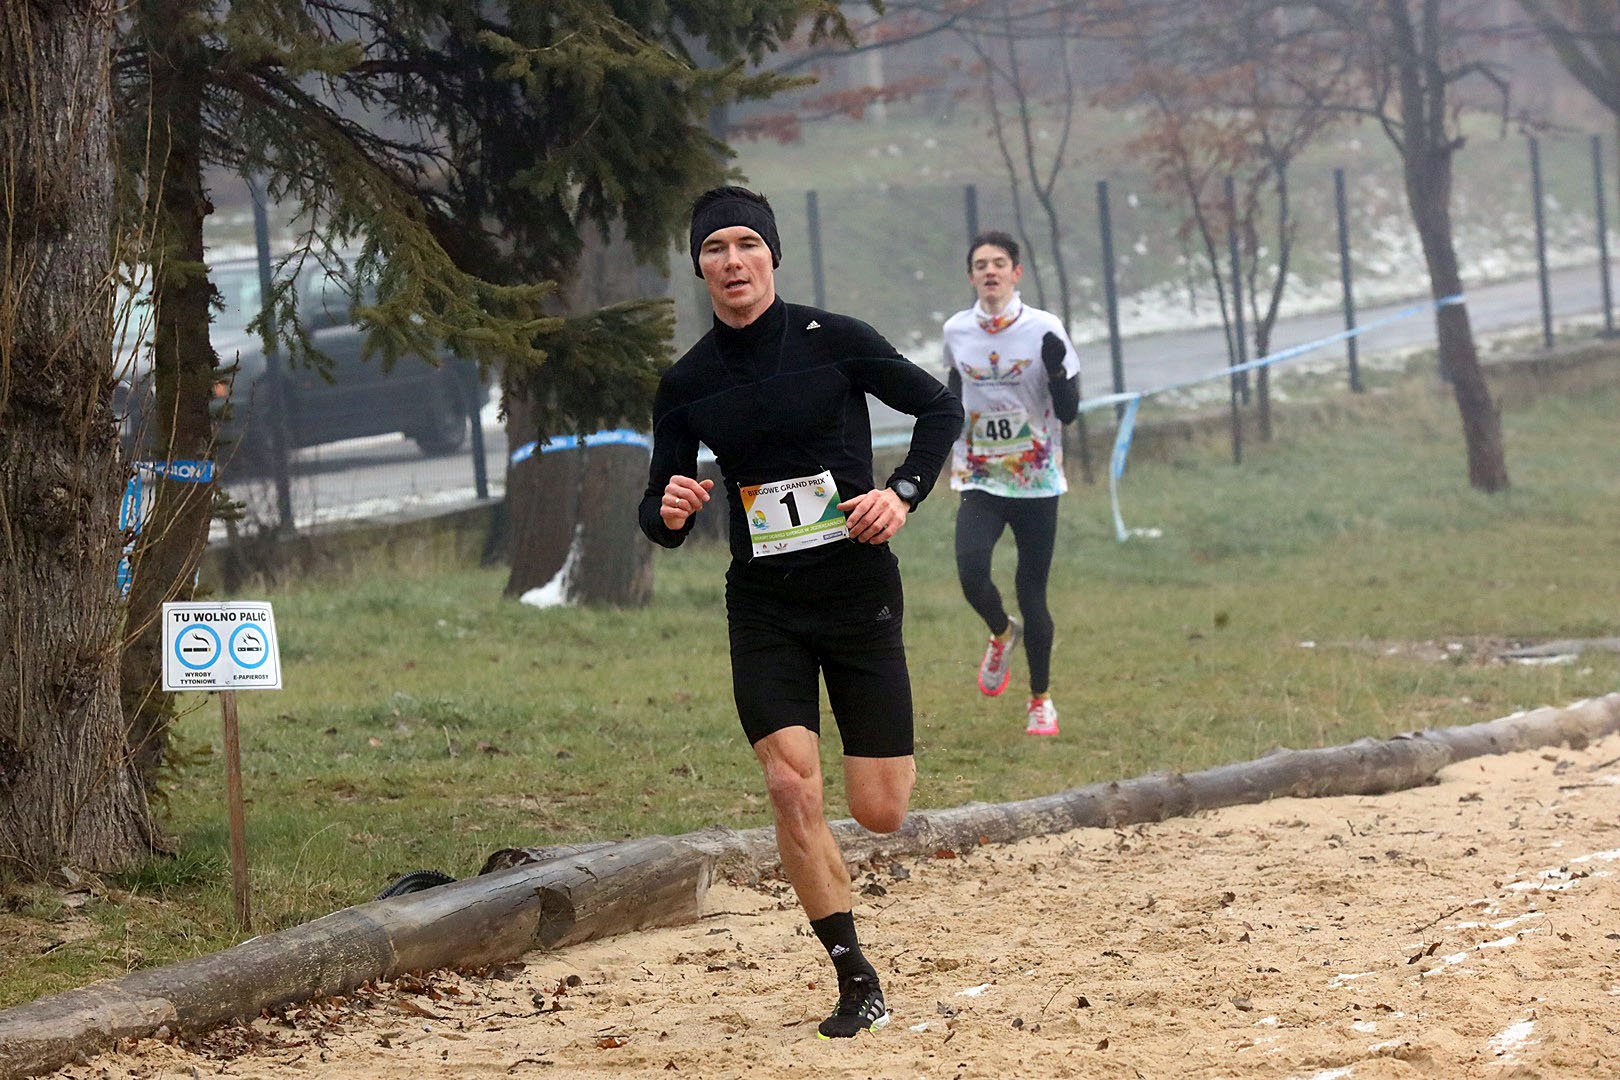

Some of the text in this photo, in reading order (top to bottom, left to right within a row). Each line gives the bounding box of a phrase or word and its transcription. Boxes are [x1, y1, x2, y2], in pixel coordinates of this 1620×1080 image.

[986, 419, 1012, 440] 48
[747, 478, 826, 497] BIEGOWE GRAND PRIX
[779, 491, 801, 527] 1
[174, 611, 266, 622] TU WOLNO PALIĆ
